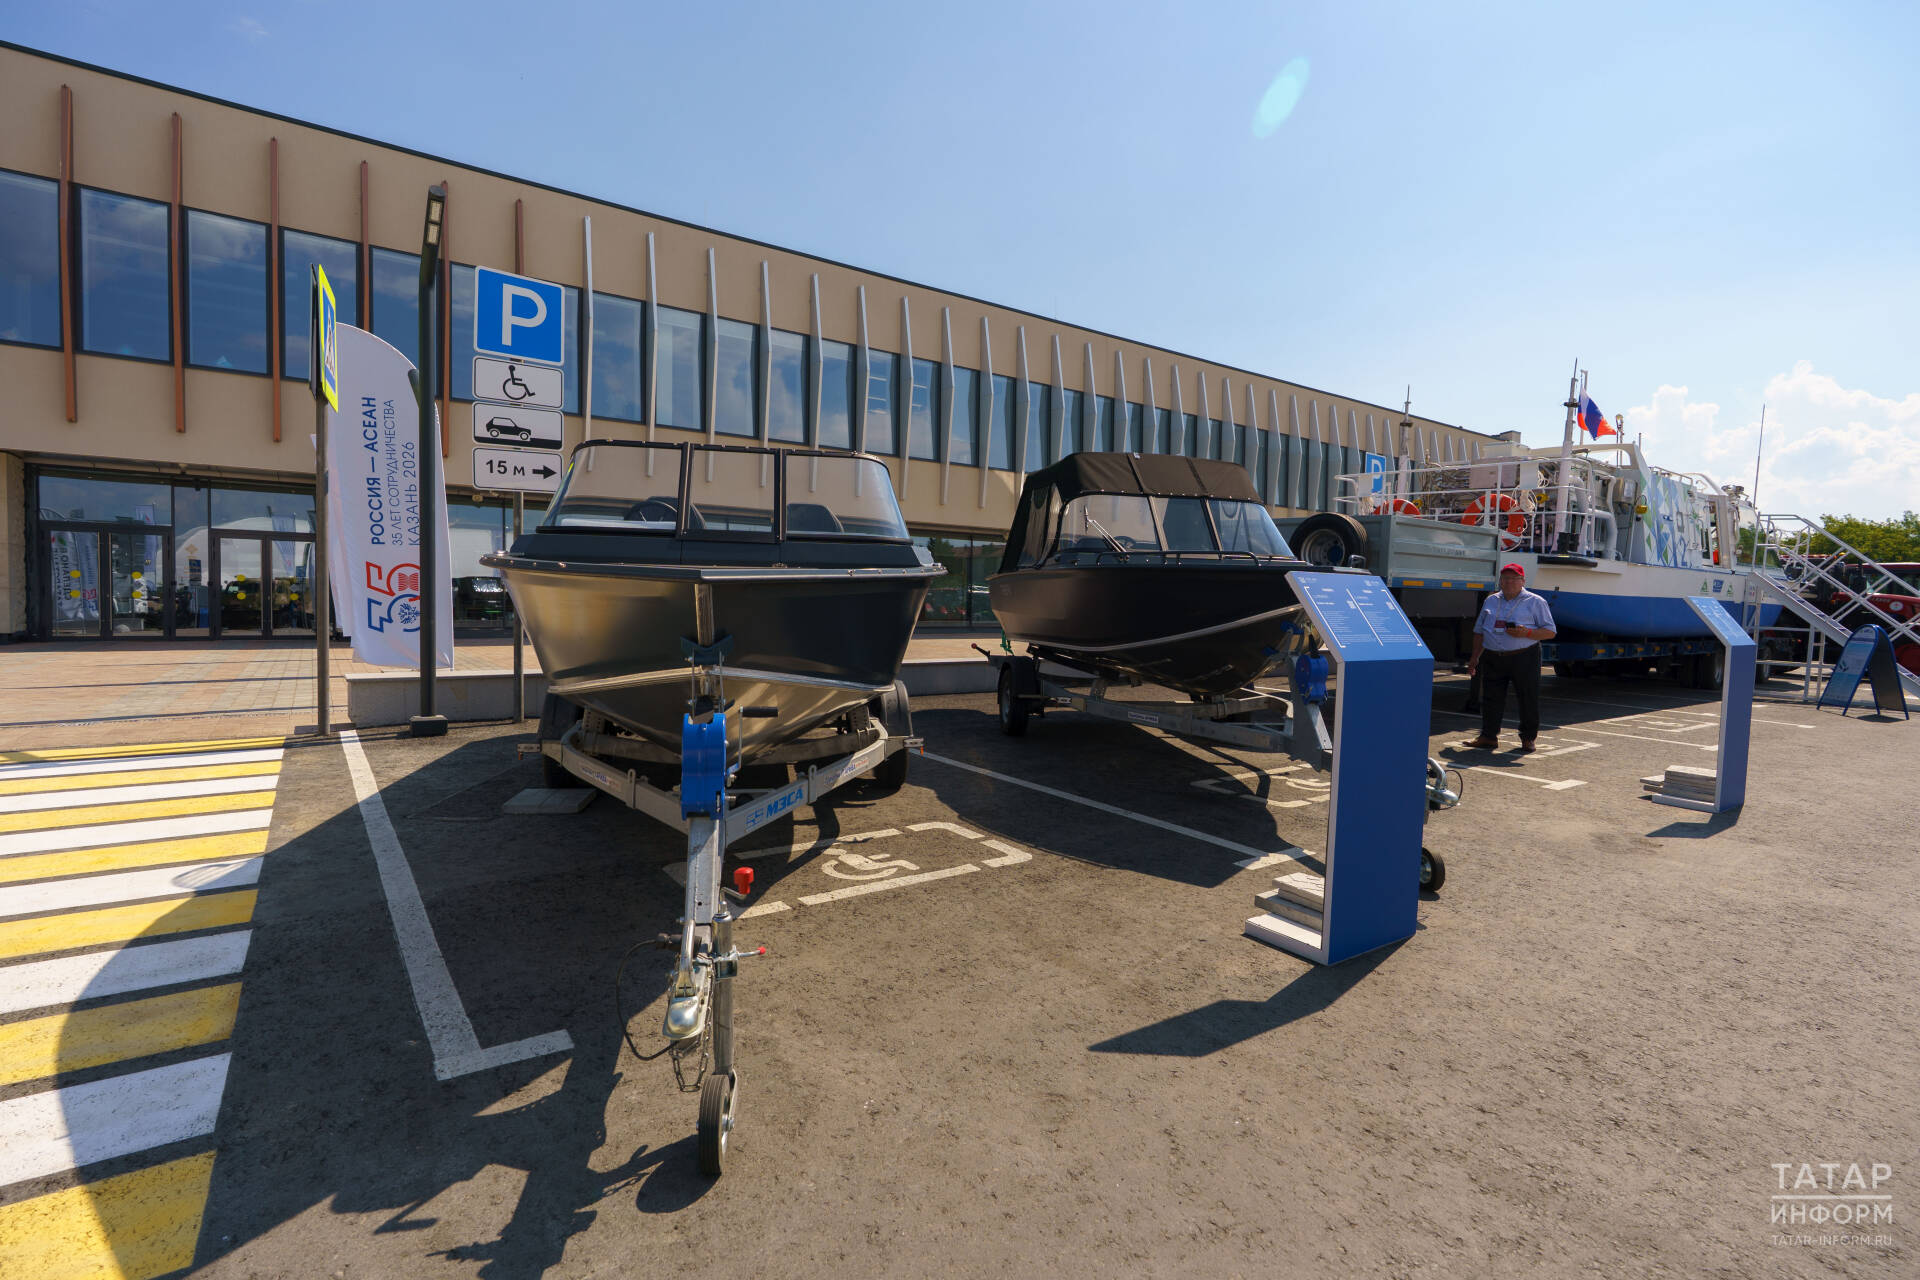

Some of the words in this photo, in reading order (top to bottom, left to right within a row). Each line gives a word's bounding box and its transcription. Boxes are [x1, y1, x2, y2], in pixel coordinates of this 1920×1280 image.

[502, 283, 547, 346] P
[361, 396, 379, 453] АСЕАН
[383, 399, 400, 506] СОТРУДНИЧЕСТВА
[402, 441, 417, 478] 2026
[486, 459, 508, 475] 15
[366, 477, 386, 545] РОССИЯ
[389, 509, 402, 530] ЛЕТ
[391, 532, 403, 546] 35
[404, 483, 420, 546] КАЗАНЬ
